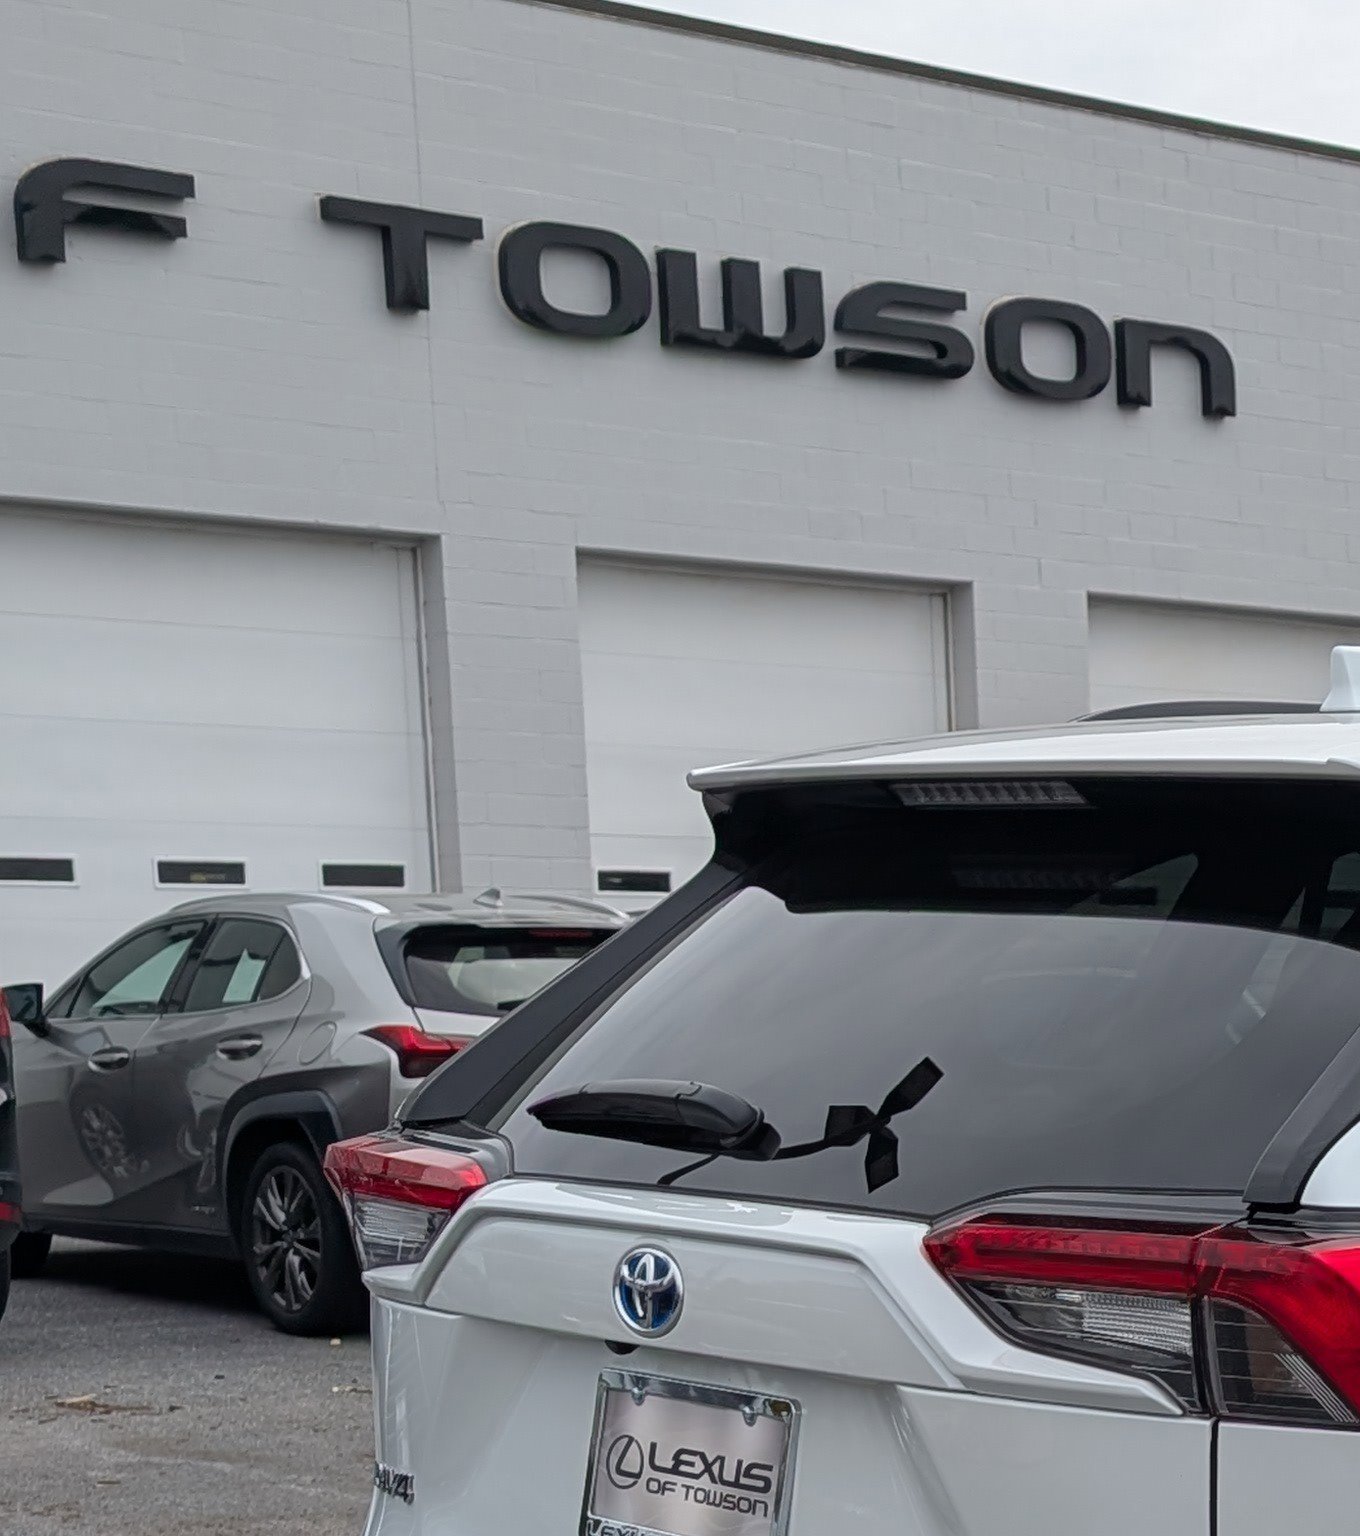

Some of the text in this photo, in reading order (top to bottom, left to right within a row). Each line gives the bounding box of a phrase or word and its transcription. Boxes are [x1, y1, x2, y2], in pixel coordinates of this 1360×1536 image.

[318, 193, 1238, 419] TOWSON
[649, 1441, 775, 1494] LEXUS
[645, 1477, 770, 1518] OF TOWSON
